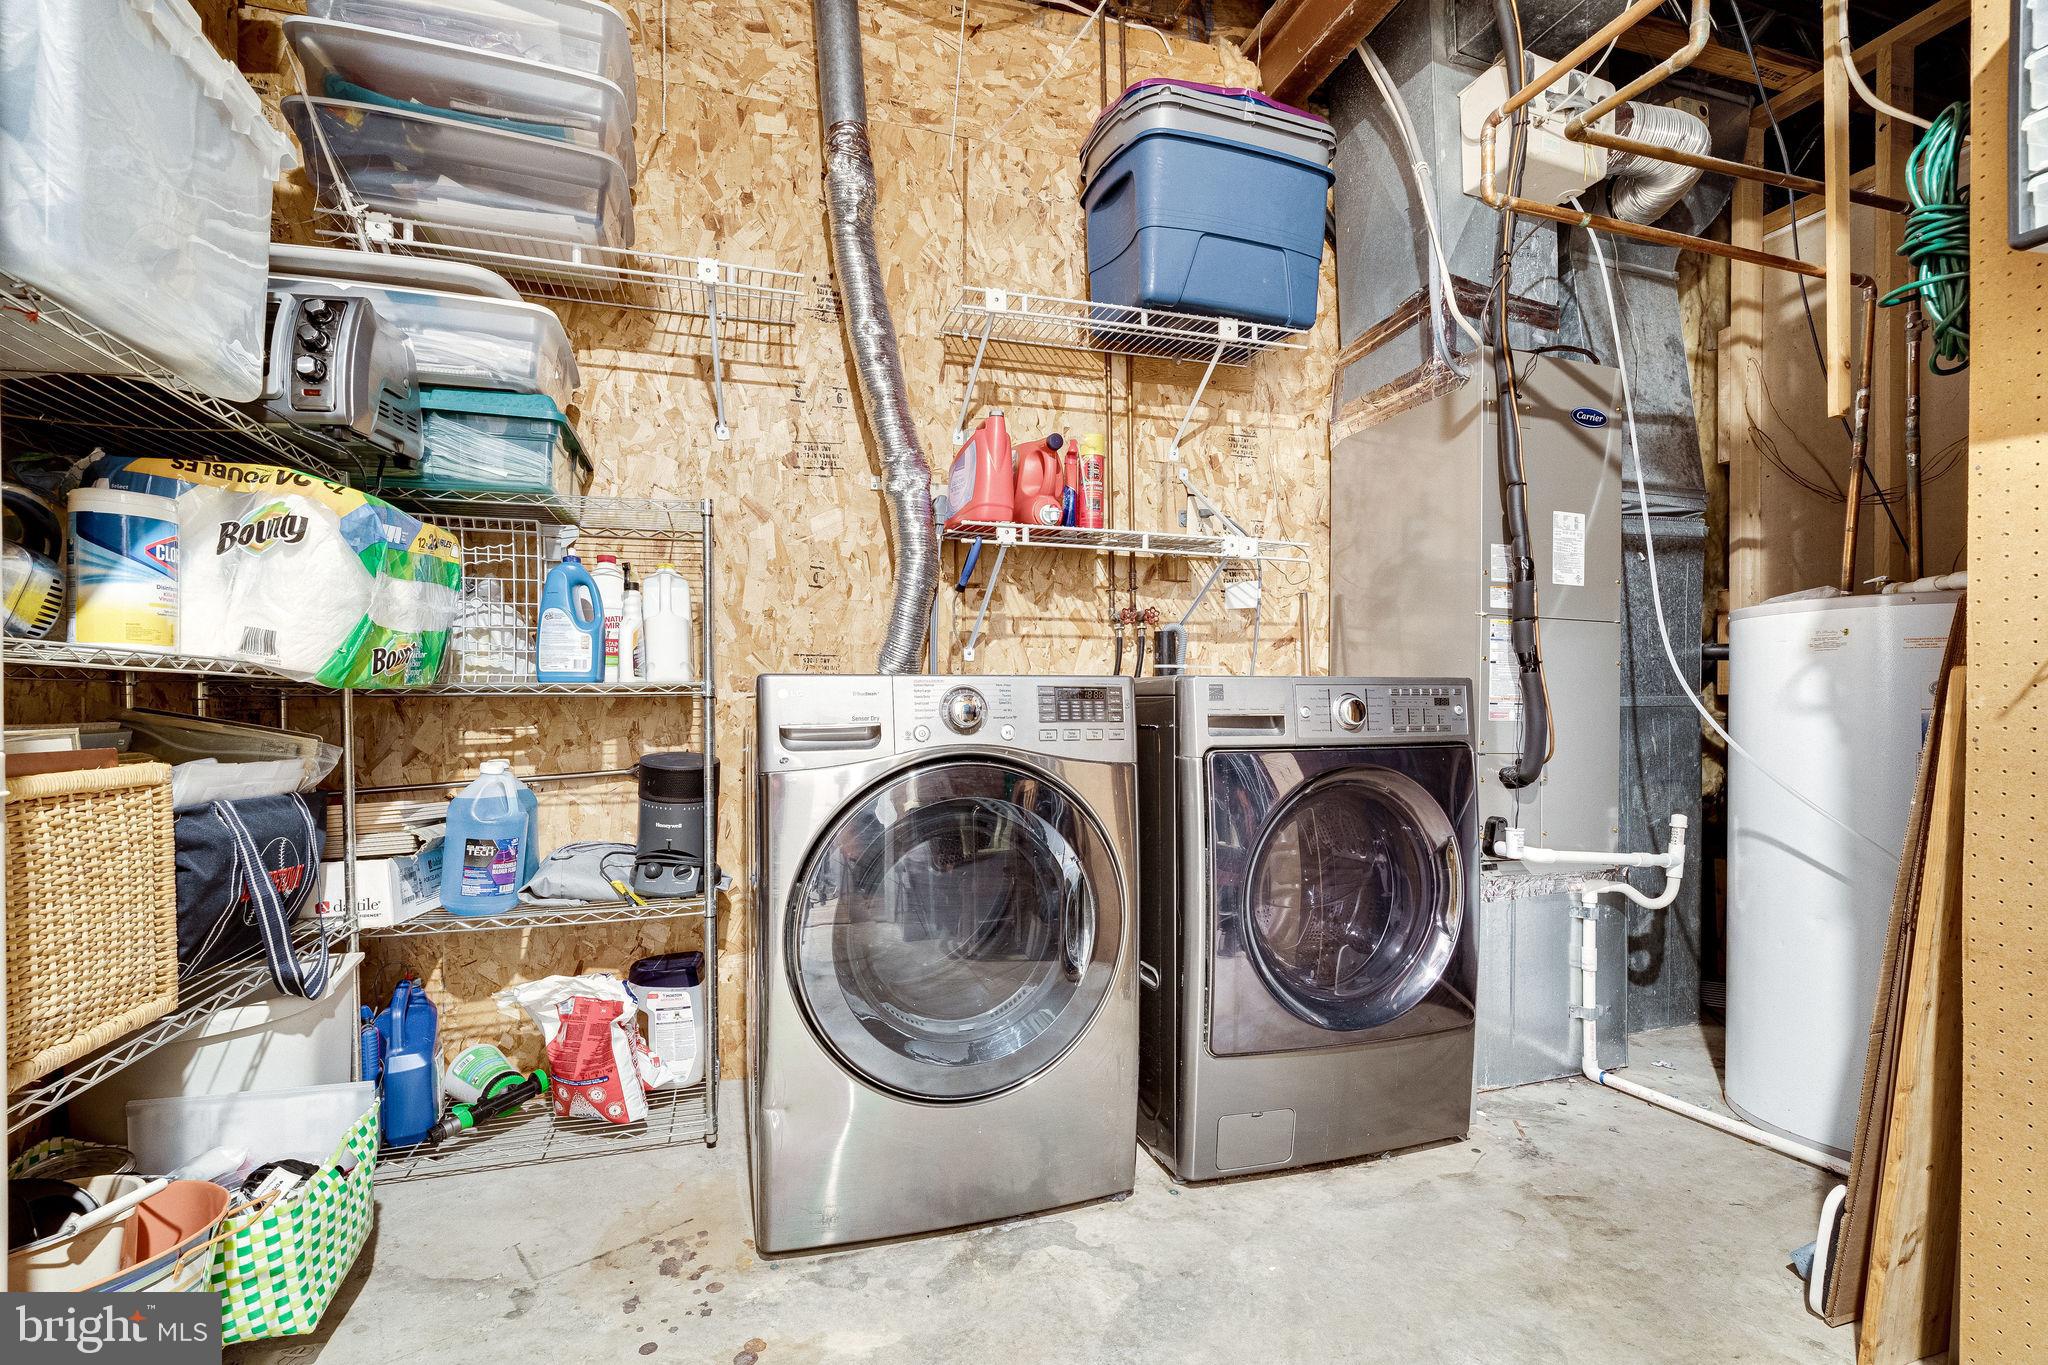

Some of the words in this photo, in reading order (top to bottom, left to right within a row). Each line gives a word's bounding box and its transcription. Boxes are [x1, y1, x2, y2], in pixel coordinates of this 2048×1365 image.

[1576, 410, 1604, 422] Carrier
[216, 512, 309, 556] Bounty
[333, 898, 377, 912] datile
